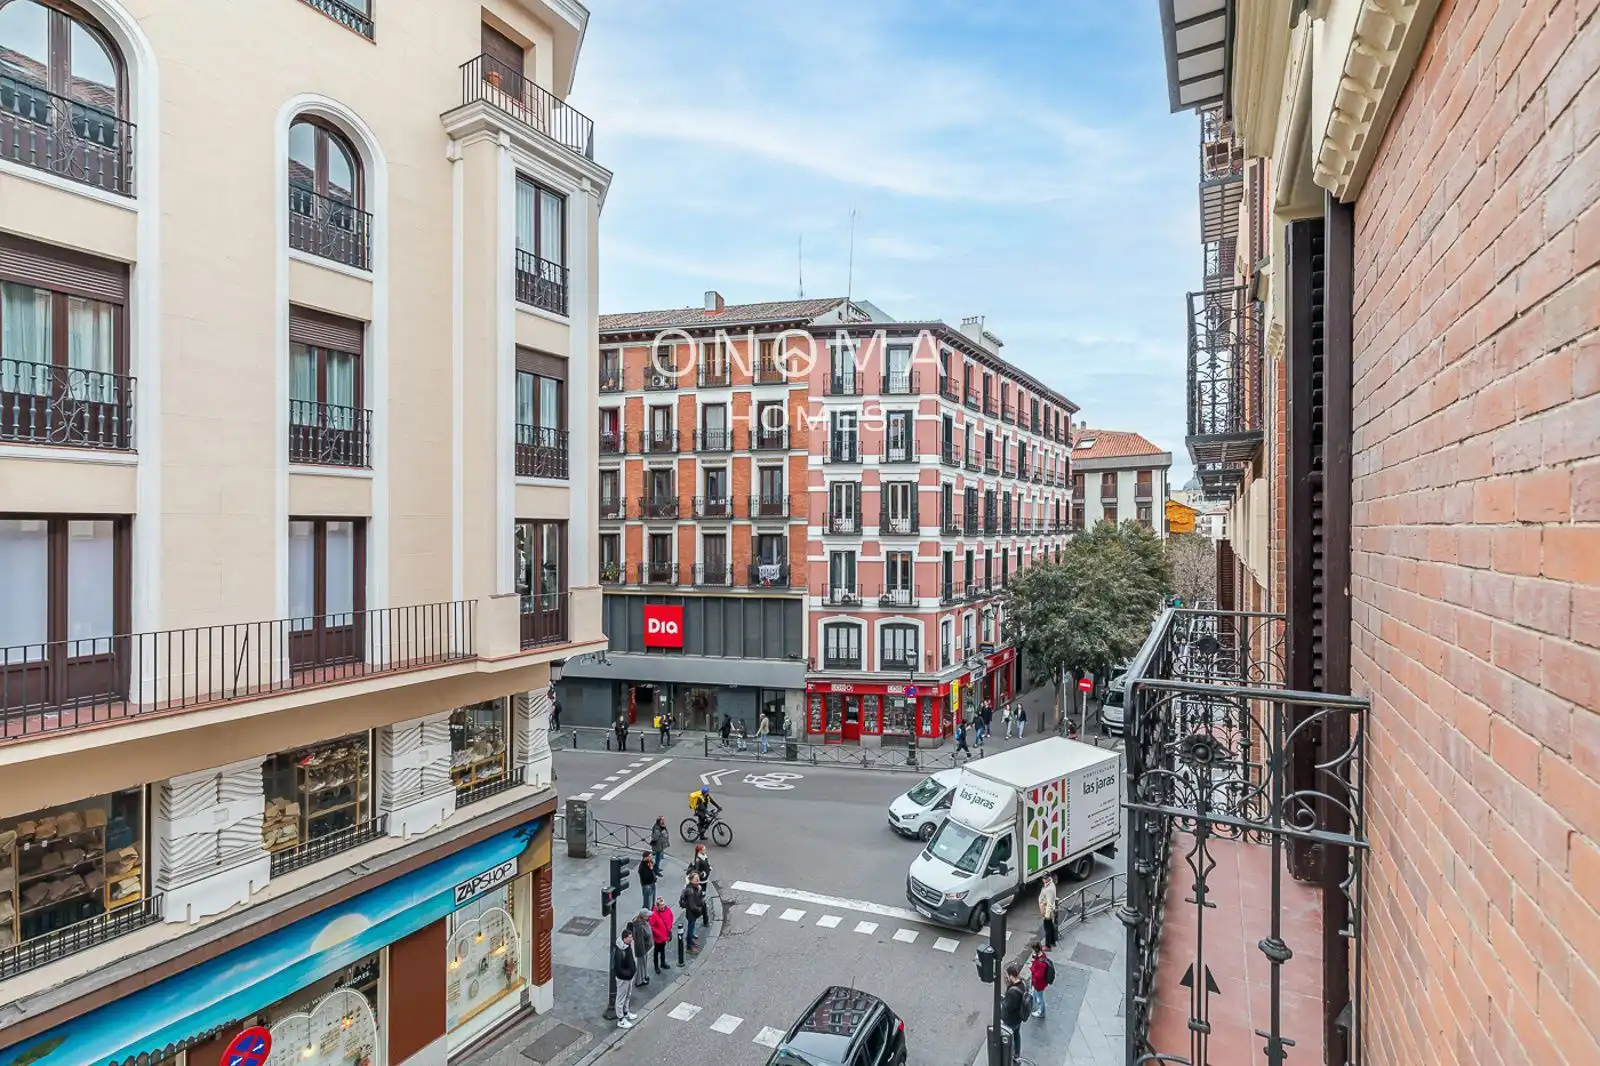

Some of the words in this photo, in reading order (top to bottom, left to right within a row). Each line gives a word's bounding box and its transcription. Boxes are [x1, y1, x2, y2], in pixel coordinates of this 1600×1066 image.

[1083, 781, 1095, 795] las
[1095, 774, 1115, 794] jaras
[960, 788, 972, 801] las
[970, 792, 995, 810] jaras
[456, 862, 513, 902] ZAPSHOP
